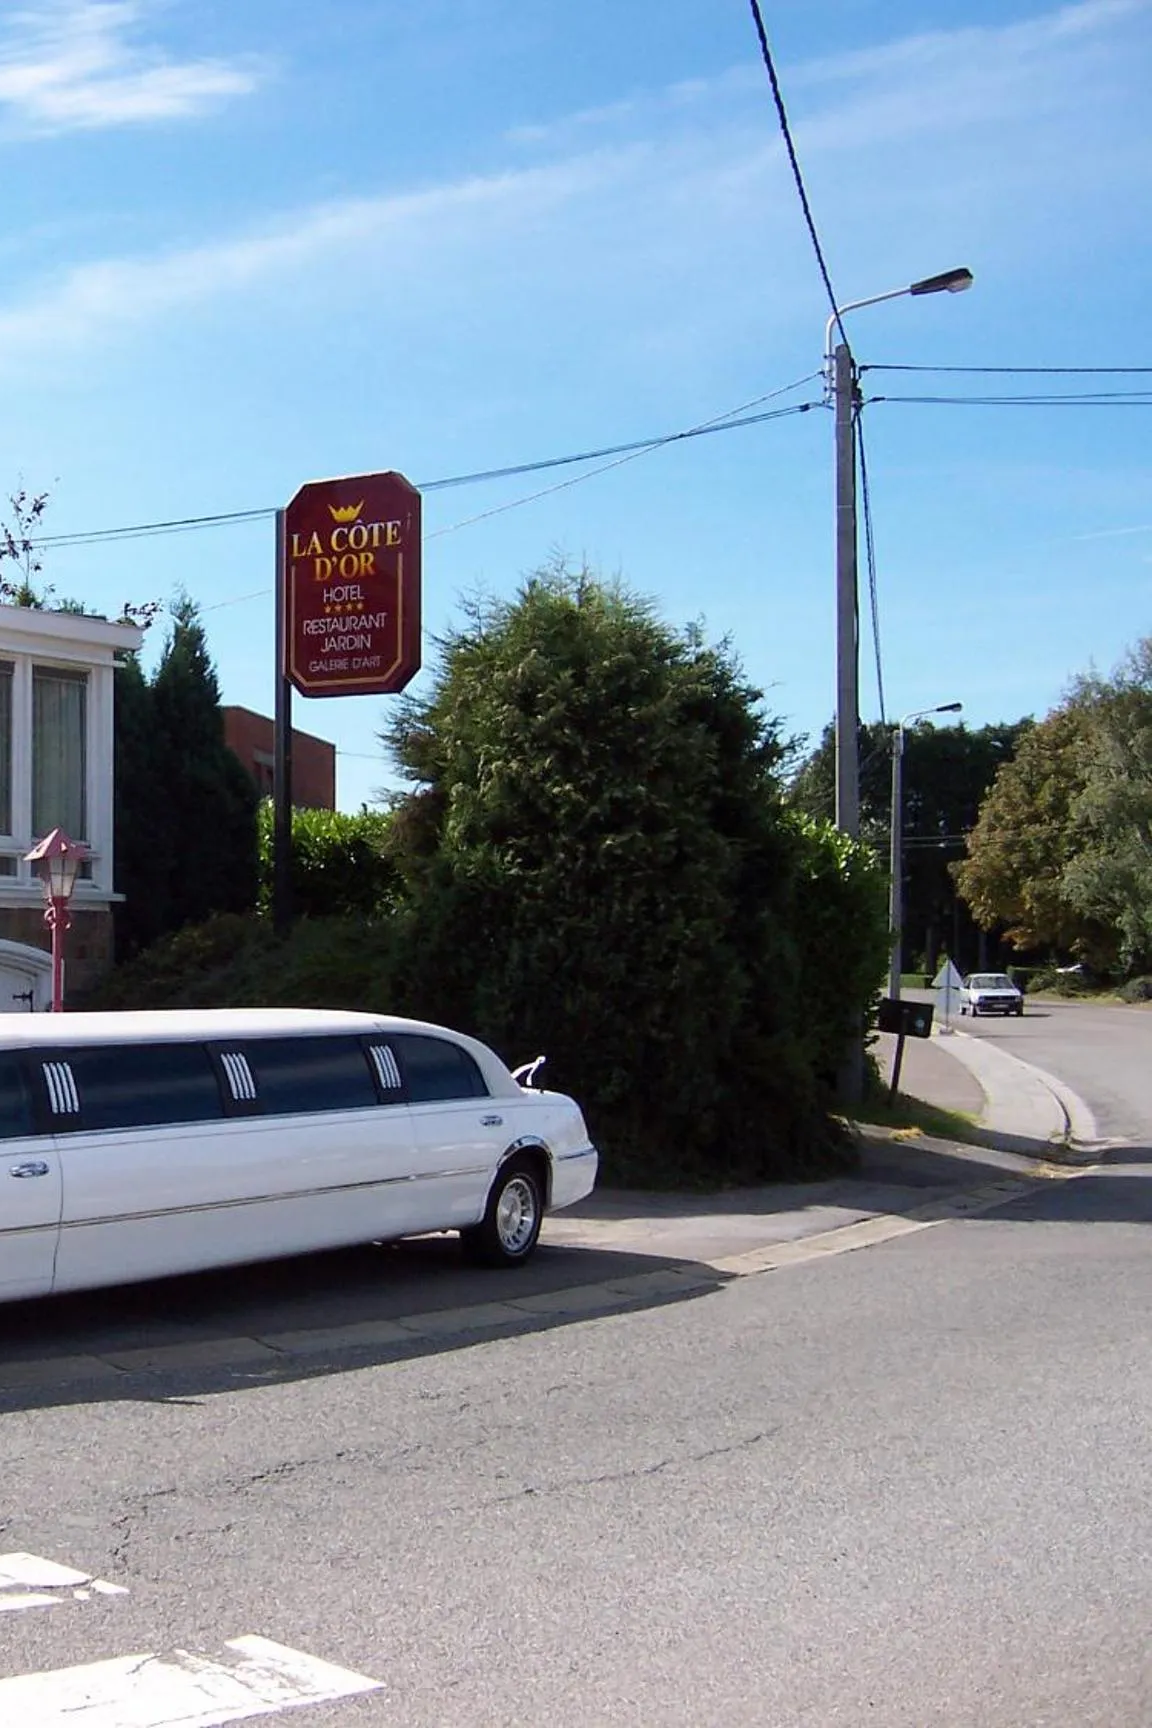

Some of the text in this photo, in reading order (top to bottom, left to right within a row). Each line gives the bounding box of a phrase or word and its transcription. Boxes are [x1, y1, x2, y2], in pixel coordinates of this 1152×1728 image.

[292, 519, 401, 557] LA CÔTE
[314, 552, 375, 580] D'OR
[323, 585, 364, 603] HOTEL
[303, 612, 387, 635] RESTAURANT
[321, 634, 371, 653] JARDIN
[309, 658, 348, 672] GALERIE
